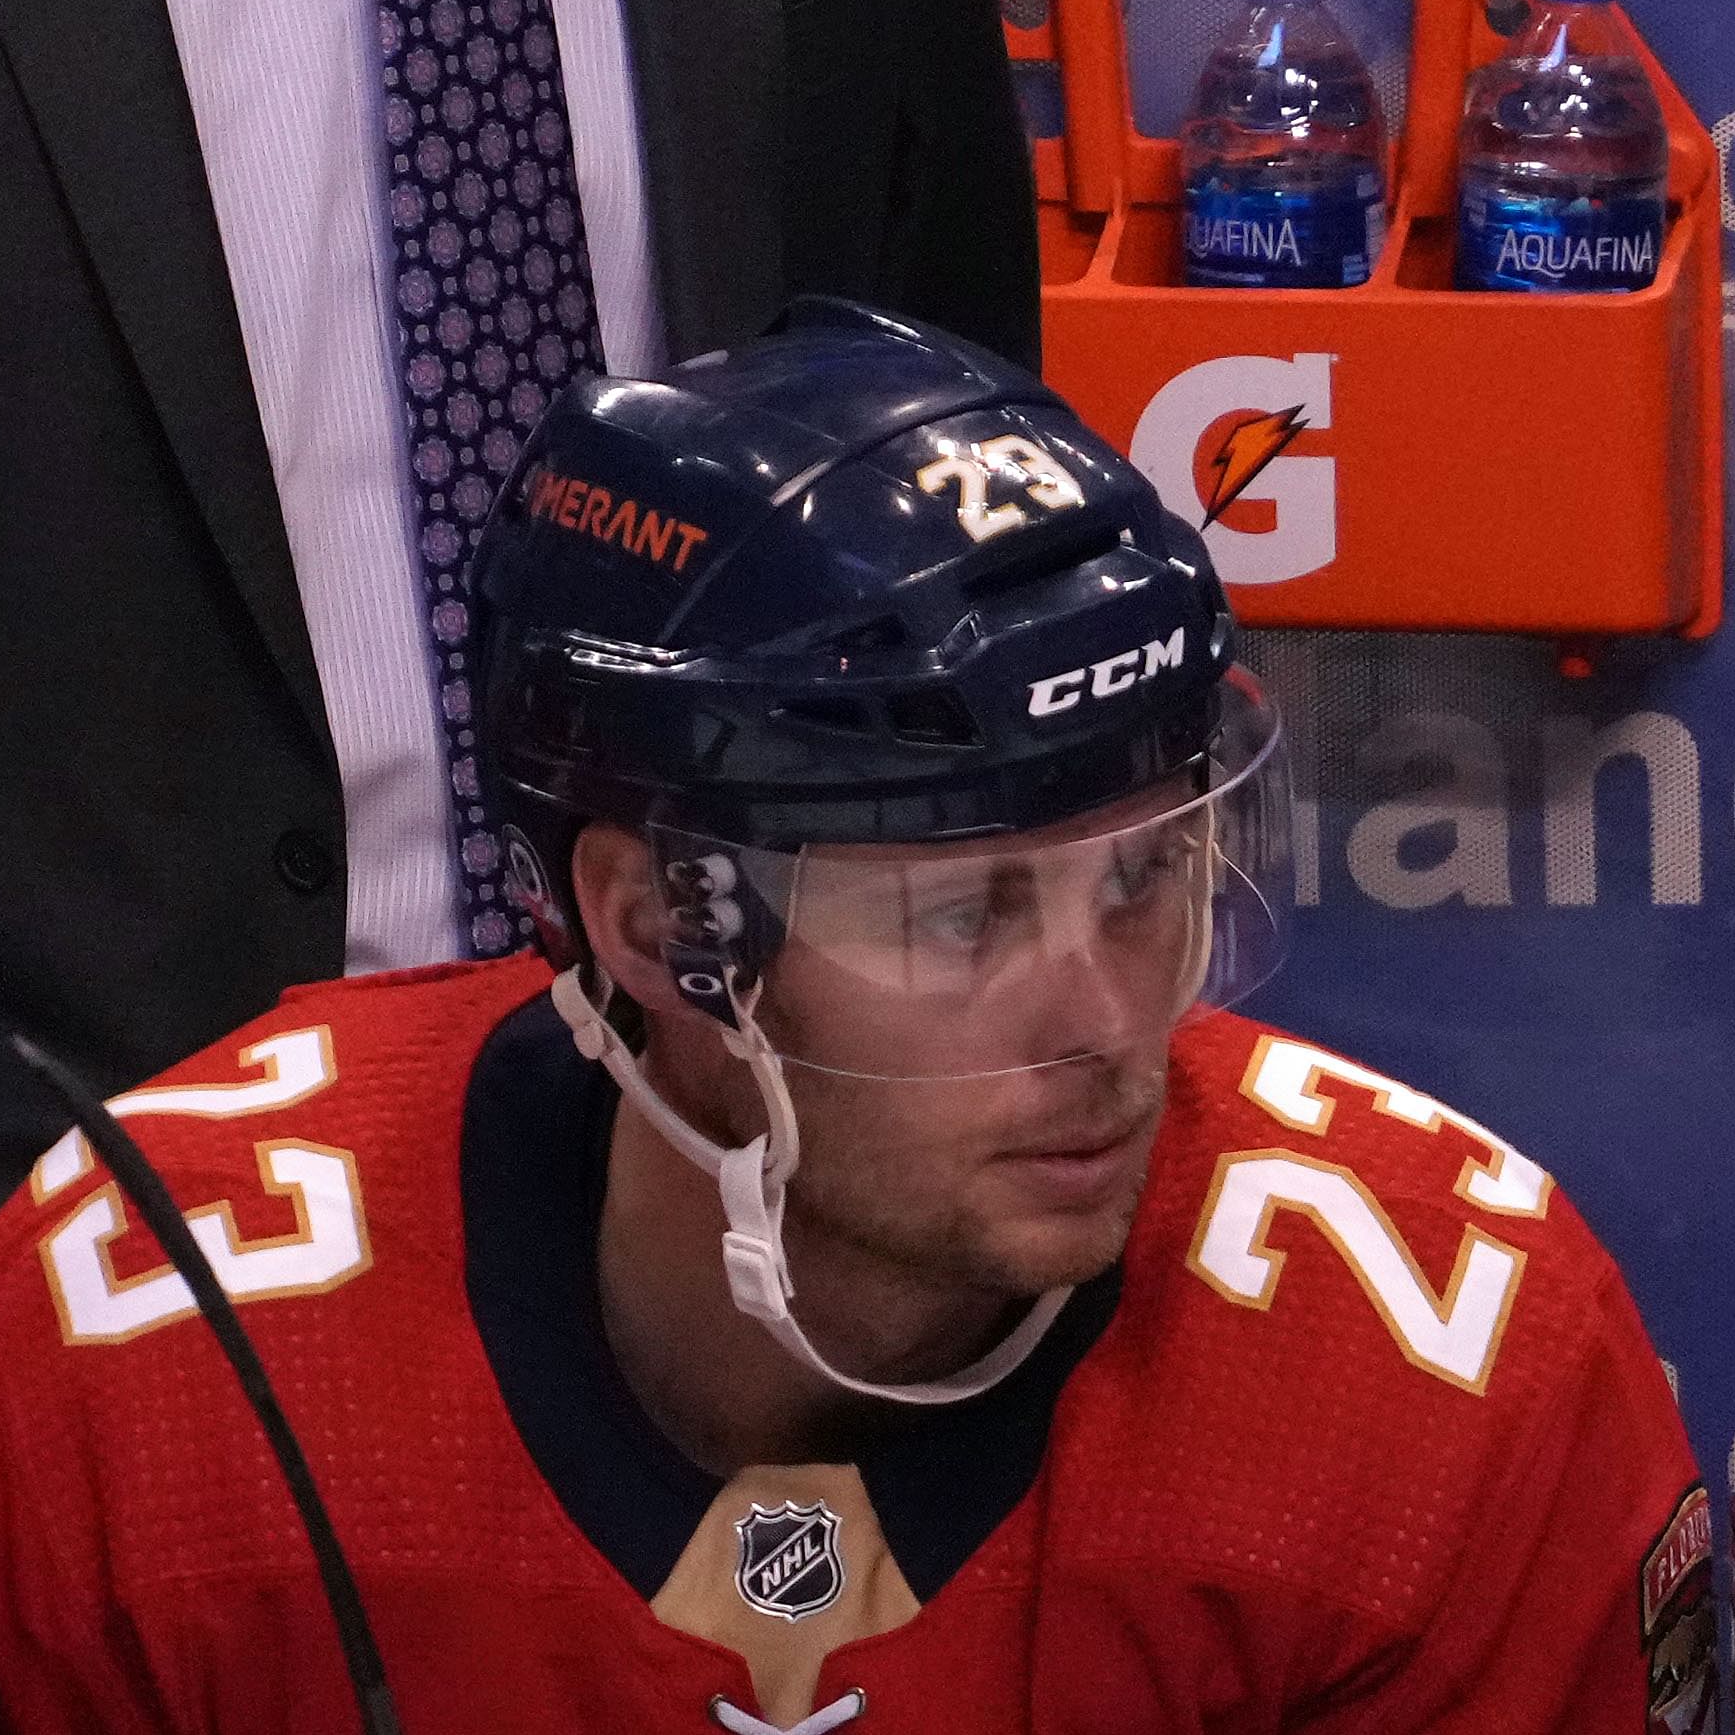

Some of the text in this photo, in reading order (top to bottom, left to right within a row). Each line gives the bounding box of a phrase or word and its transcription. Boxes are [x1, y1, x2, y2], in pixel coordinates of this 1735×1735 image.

[1185, 217, 1303, 267] UAFINA
[1495, 228, 1655, 279] AQUAFINA
[1129, 352, 1337, 585] G
[530, 470, 709, 572] MERANT
[1025, 626, 1188, 720] CCM
[1186, 1033, 1554, 1396] 23
[761, 1532, 822, 1596] NHL
